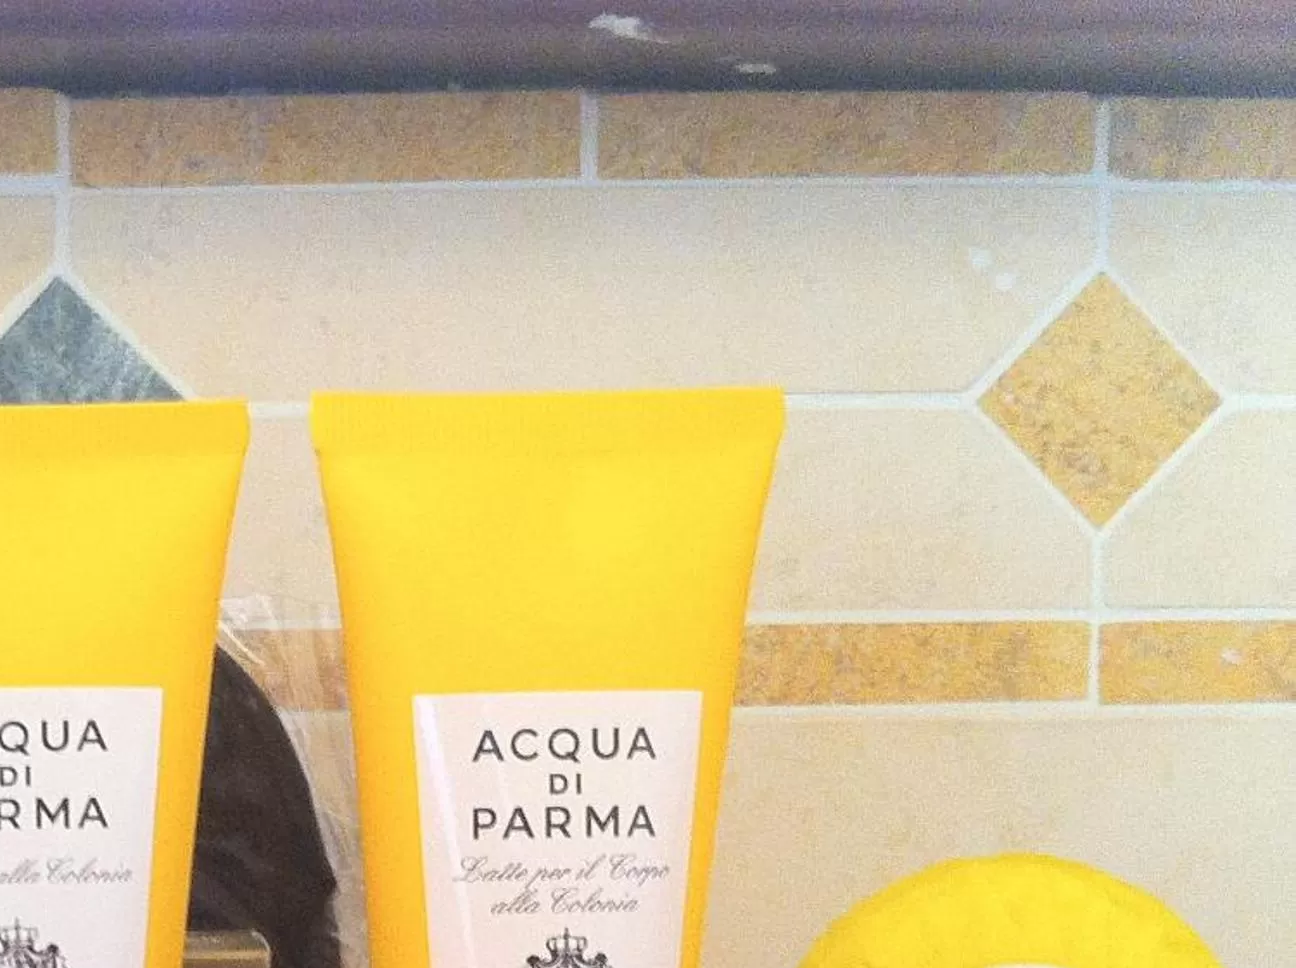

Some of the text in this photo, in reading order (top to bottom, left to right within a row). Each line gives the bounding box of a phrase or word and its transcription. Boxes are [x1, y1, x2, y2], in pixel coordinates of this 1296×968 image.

[472, 727, 657, 763] ACQUA
[548, 773, 582, 795] DI
[472, 804, 656, 840] PARMA
[45, 856, 134, 885] Colonia
[452, 856, 529, 884] Latte
[524, 863, 571, 892] per
[608, 853, 670, 887] Corpo
[490, 887, 640, 915] alla Colonia
